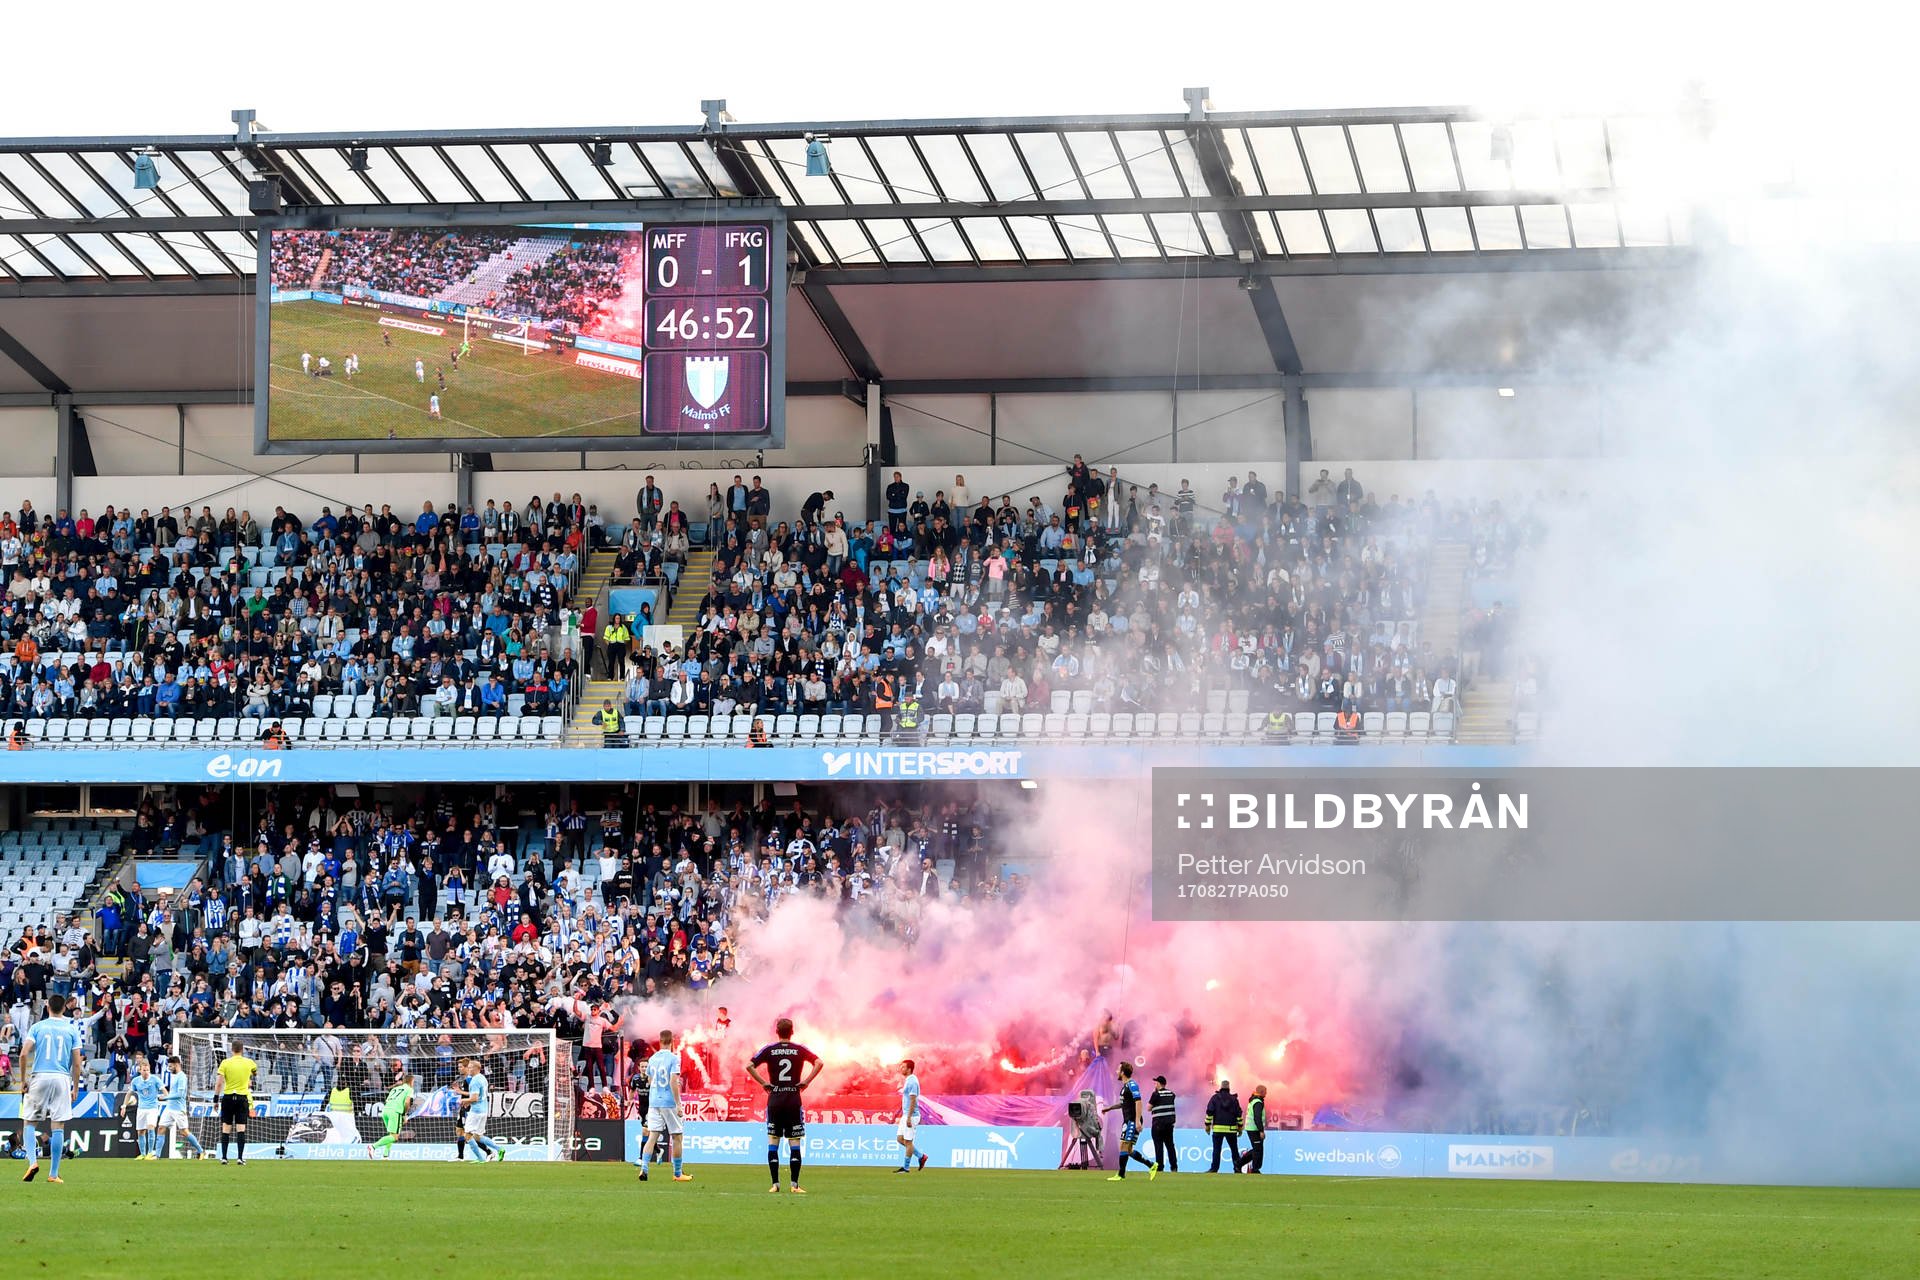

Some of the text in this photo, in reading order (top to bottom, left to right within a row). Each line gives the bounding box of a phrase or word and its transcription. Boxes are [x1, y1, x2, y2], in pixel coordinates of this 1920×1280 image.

[653, 234, 687, 249] MFF
[725, 232, 763, 248] IFKG
[658, 255, 679, 288] 0
[738, 254, 751, 286] 1
[656, 307, 756, 340] 46:52
[681, 403, 732, 421] Malmö FF
[855, 751, 1022, 775] INTERSPORT
[44, 1034, 64, 1061] 11
[771, 1048, 798, 1056] SERNEKE
[650, 1066, 669, 1088] 23
[778, 1058, 792, 1081] 2
[388, 1088, 405, 1100] 27
[307, 1146, 344, 1159] Halva
[391, 1146, 419, 1159] med
[810, 1136, 900, 1151] exakta
[951, 1148, 1008, 1169] PUMA
[1295, 1149, 1375, 1163] Swedbank
[1455, 1150, 1530, 1169] MALMÖ
